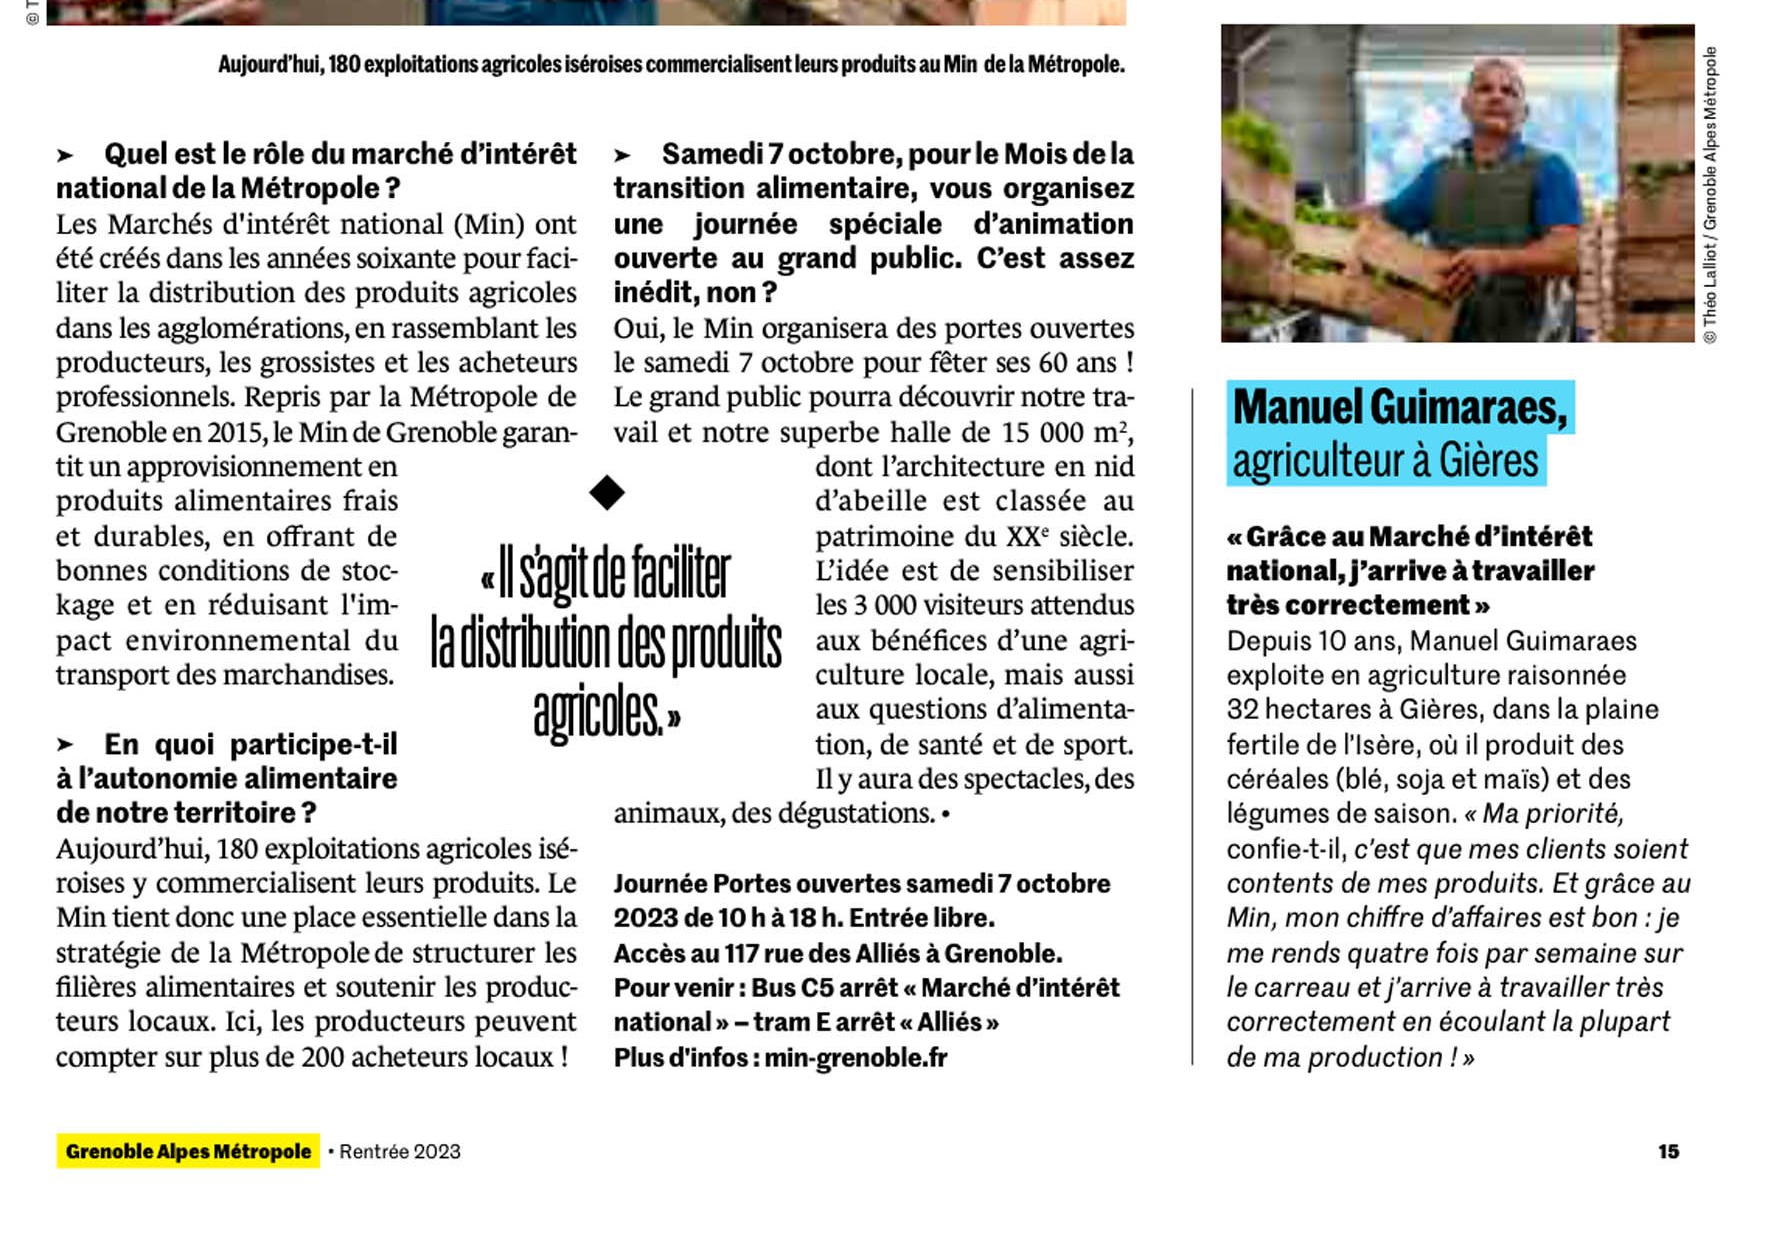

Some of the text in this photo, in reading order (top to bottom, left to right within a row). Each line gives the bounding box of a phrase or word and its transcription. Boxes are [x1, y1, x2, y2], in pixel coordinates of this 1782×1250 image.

[218, 53, 1125, 77] Aujourd’hui, 180 exploitations agricoles iséroises commercialisent leurs produits au Min de la Métropole.
[1702, 46, 1719, 119] Métropole
[105, 140, 577, 168] Quel est le rôle du marché d’intérêt
[662, 140, 1134, 170] Samedi 7 octobre, pour le Mois de la
[1702, 122, 1719, 161] Alpes
[56, 174, 166, 198] national
[172, 174, 205, 198] de
[212, 174, 235, 198] la
[241, 174, 379, 204] Métropole
[1702, 166, 1716, 230] Grenoble
[56, 211, 576, 238] Les Marchés d'intérêt national (Min) ont
[1702, 243, 1716, 287] Lalliot
[1702, 292, 1716, 326] Théo
[1234, 386, 1567, 431] Manuel Guimaraes,
[1232, 439, 1538, 485] agriculteur à Gières
[499, 543, 513, 598] Il
[519, 543, 588, 608] s’agit
[593, 543, 625, 598] de
[631, 543, 731, 598] faciliter
[431, 613, 782, 678] la distribution des produits
[1228, 627, 1636, 656] Depuis 10 ans, Manuel Guimaraes
[533, 681, 663, 747] agricoles.
[613, 871, 1110, 893] Journée Portes ouvertes samedi 7 octobre
[614, 1045, 664, 1067] Plus
[669, 1045, 748, 1067] d'infos
[765, 1045, 948, 1074] min-grenoble.fr
[65, 1142, 311, 1163] Grenoble Alpes Métropole
[340, 1143, 460, 1159] Rentrée 2023
[1658, 1143, 1679, 1159] 15
